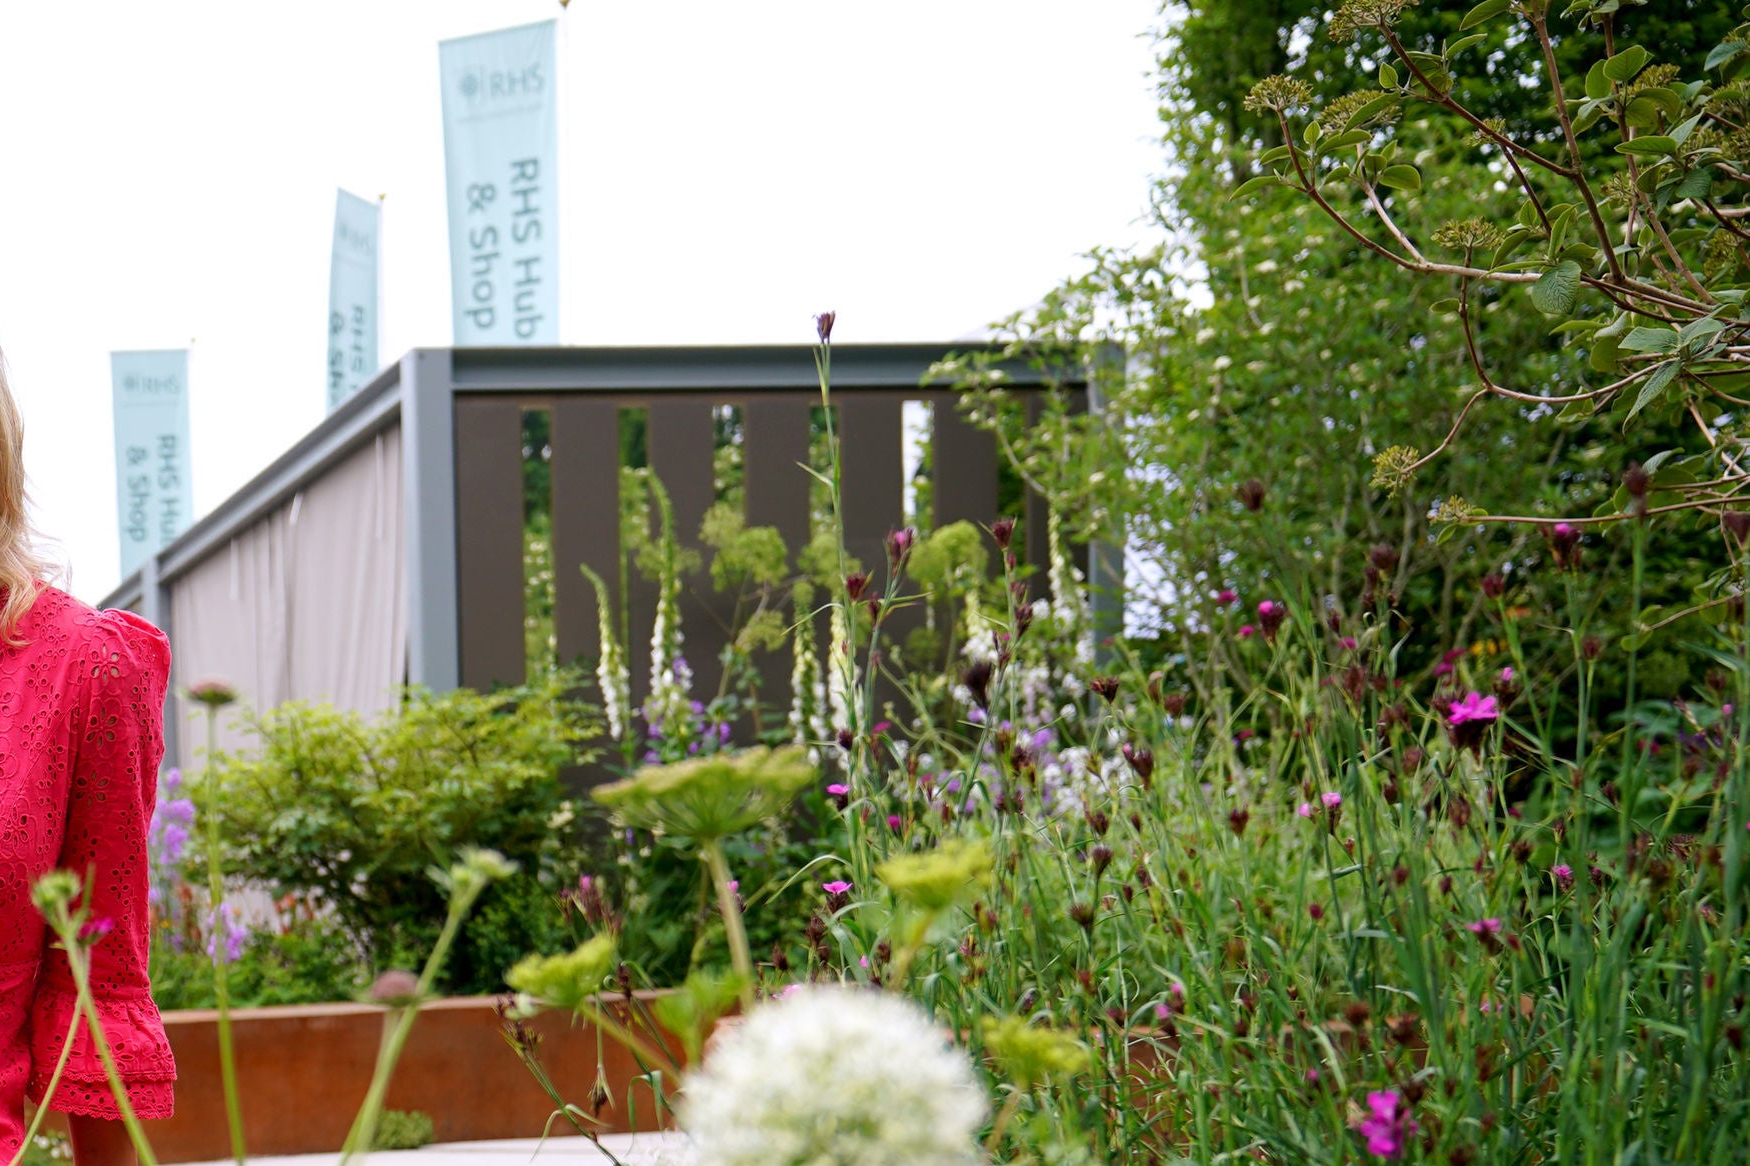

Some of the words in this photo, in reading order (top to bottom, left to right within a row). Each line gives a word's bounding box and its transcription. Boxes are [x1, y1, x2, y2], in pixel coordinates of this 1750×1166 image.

[489, 62, 544, 97] RHS
[466, 183, 496, 214] &
[510, 157, 543, 245] RHS
[464, 226, 500, 330] Shop
[513, 256, 544, 340] Hub
[350, 305, 364, 372] RHS
[141, 374, 180, 394] RHS
[126, 446, 148, 465] &
[157, 433, 181, 491] RHS
[124, 474, 151, 542] Shop
